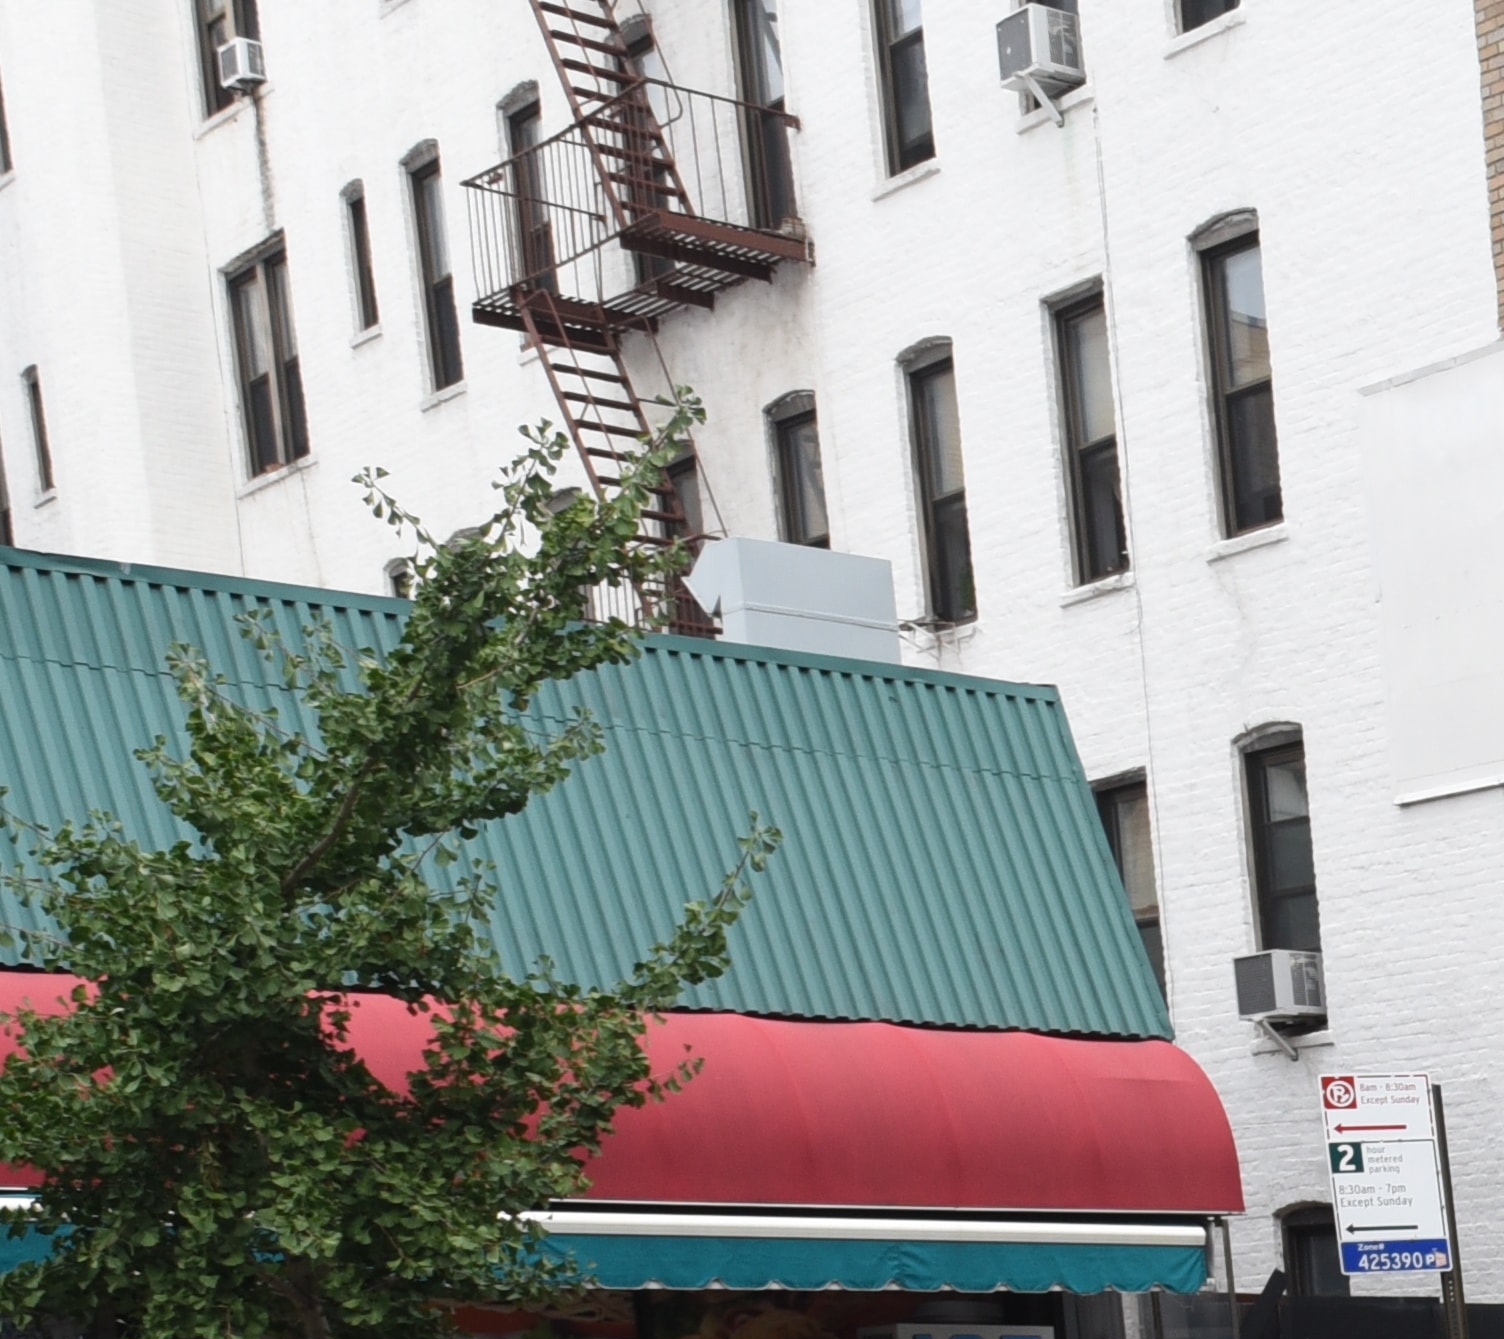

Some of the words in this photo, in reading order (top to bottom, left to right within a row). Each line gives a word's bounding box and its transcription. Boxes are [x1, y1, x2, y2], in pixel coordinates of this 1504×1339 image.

[1359, 1083, 1376, 1091] 8am
[1385, 1082, 1417, 1091] 8:30am
[1360, 1095, 1388, 1106] Except
[1390, 1095, 1420, 1105] Sunday
[1366, 1145, 1385, 1154] hour
[1337, 1144, 1356, 1172] 2
[1367, 1155, 1403, 1163] metered
[1368, 1164, 1401, 1174] parking
[1338, 1185, 1376, 1195] 8:30am
[1386, 1184, 1407, 1195] 7pm
[1340, 1198, 1374, 1208] Except
[1377, 1196, 1414, 1207] Sunday
[1358, 1252, 1423, 1270] 425390
